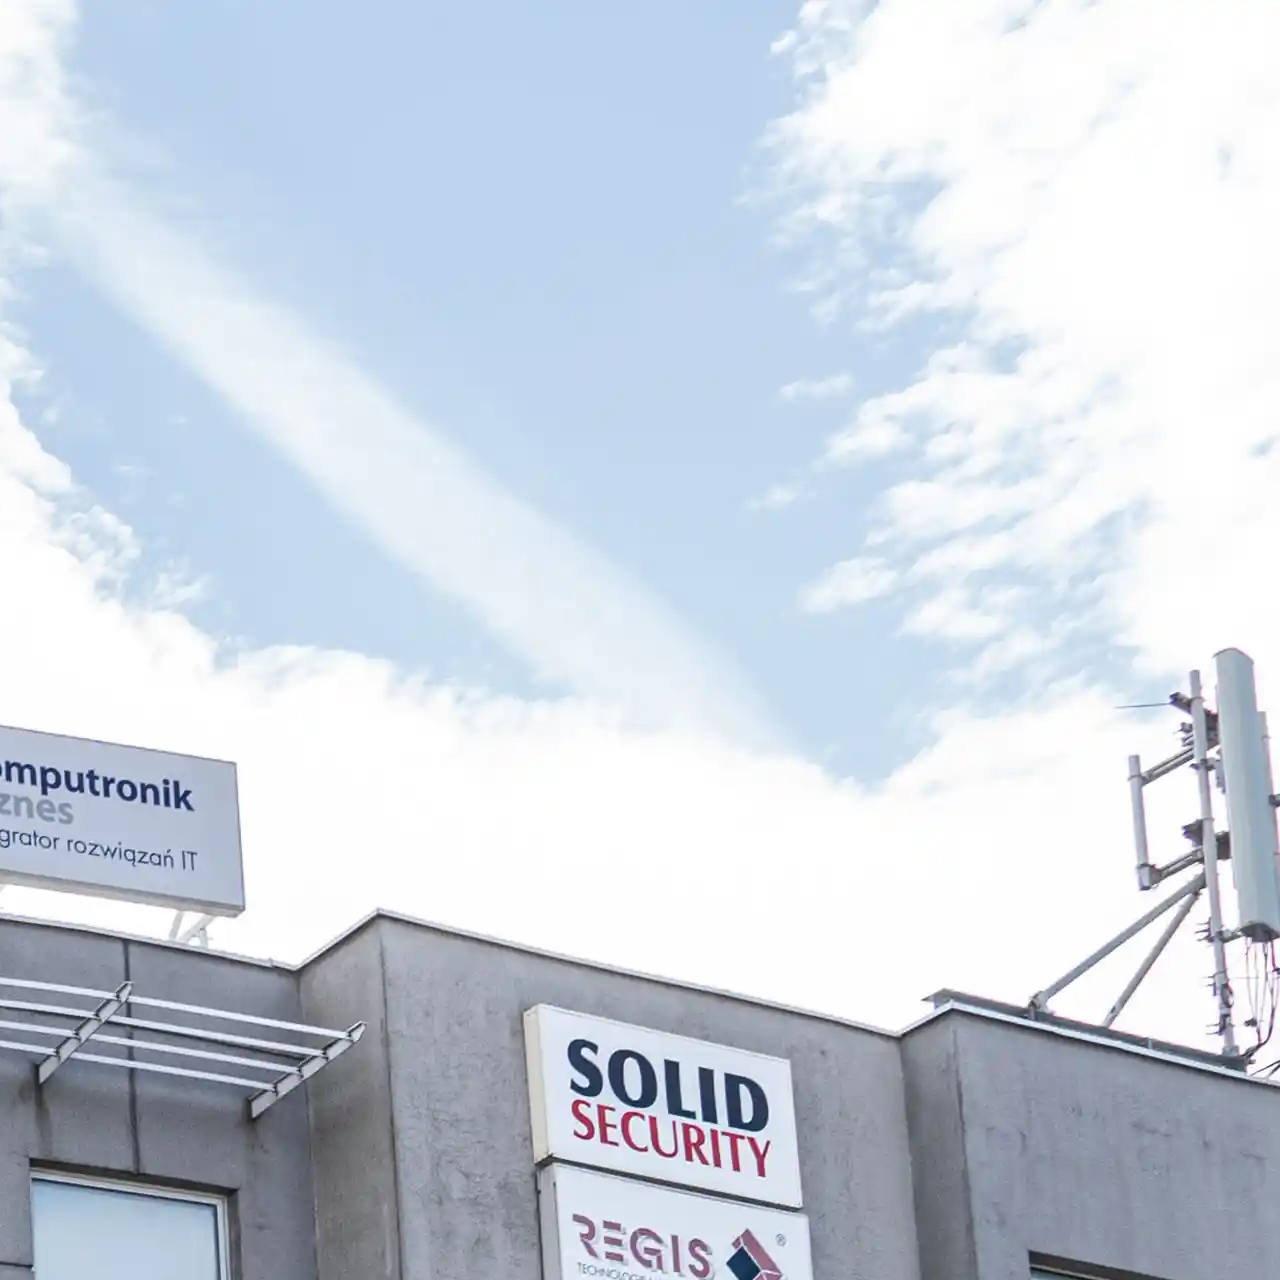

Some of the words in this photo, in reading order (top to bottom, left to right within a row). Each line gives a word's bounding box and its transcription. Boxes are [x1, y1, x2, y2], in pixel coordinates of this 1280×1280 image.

[67, 839, 175, 868] rozwiązań
[181, 850, 198, 871] IT
[567, 1038, 769, 1132] SOLID
[571, 1099, 771, 1177] SECURITY
[572, 1213, 714, 1280] REGIS
